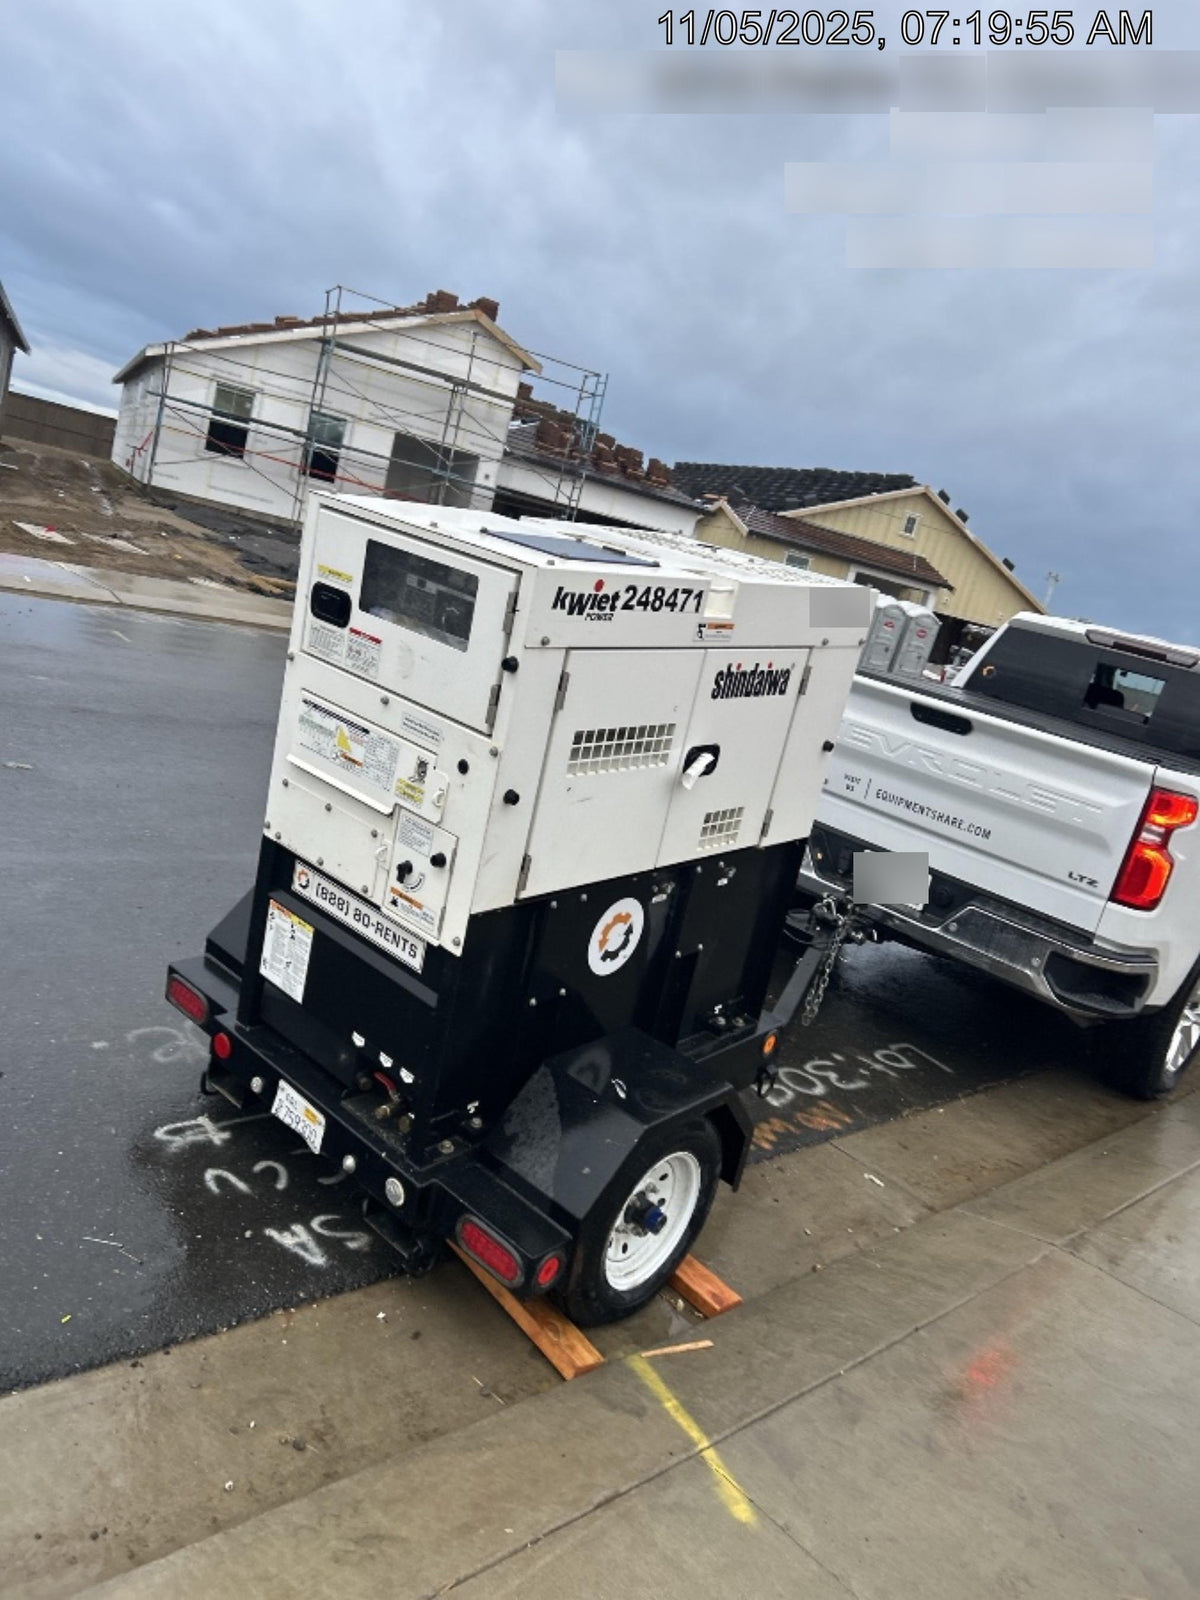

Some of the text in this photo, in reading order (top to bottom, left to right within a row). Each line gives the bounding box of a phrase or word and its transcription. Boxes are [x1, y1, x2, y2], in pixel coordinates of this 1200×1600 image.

[551, 578, 704, 615] kwiet 248471
[711, 662, 792, 700] shindaiwa
[875, 788, 992, 840] EQUIPMENTSHARE.COM
[1068, 870, 1100, 888] LTZ
[315, 881, 351, 917] (888)
[352, 906, 419, 960] 80-RENTS
